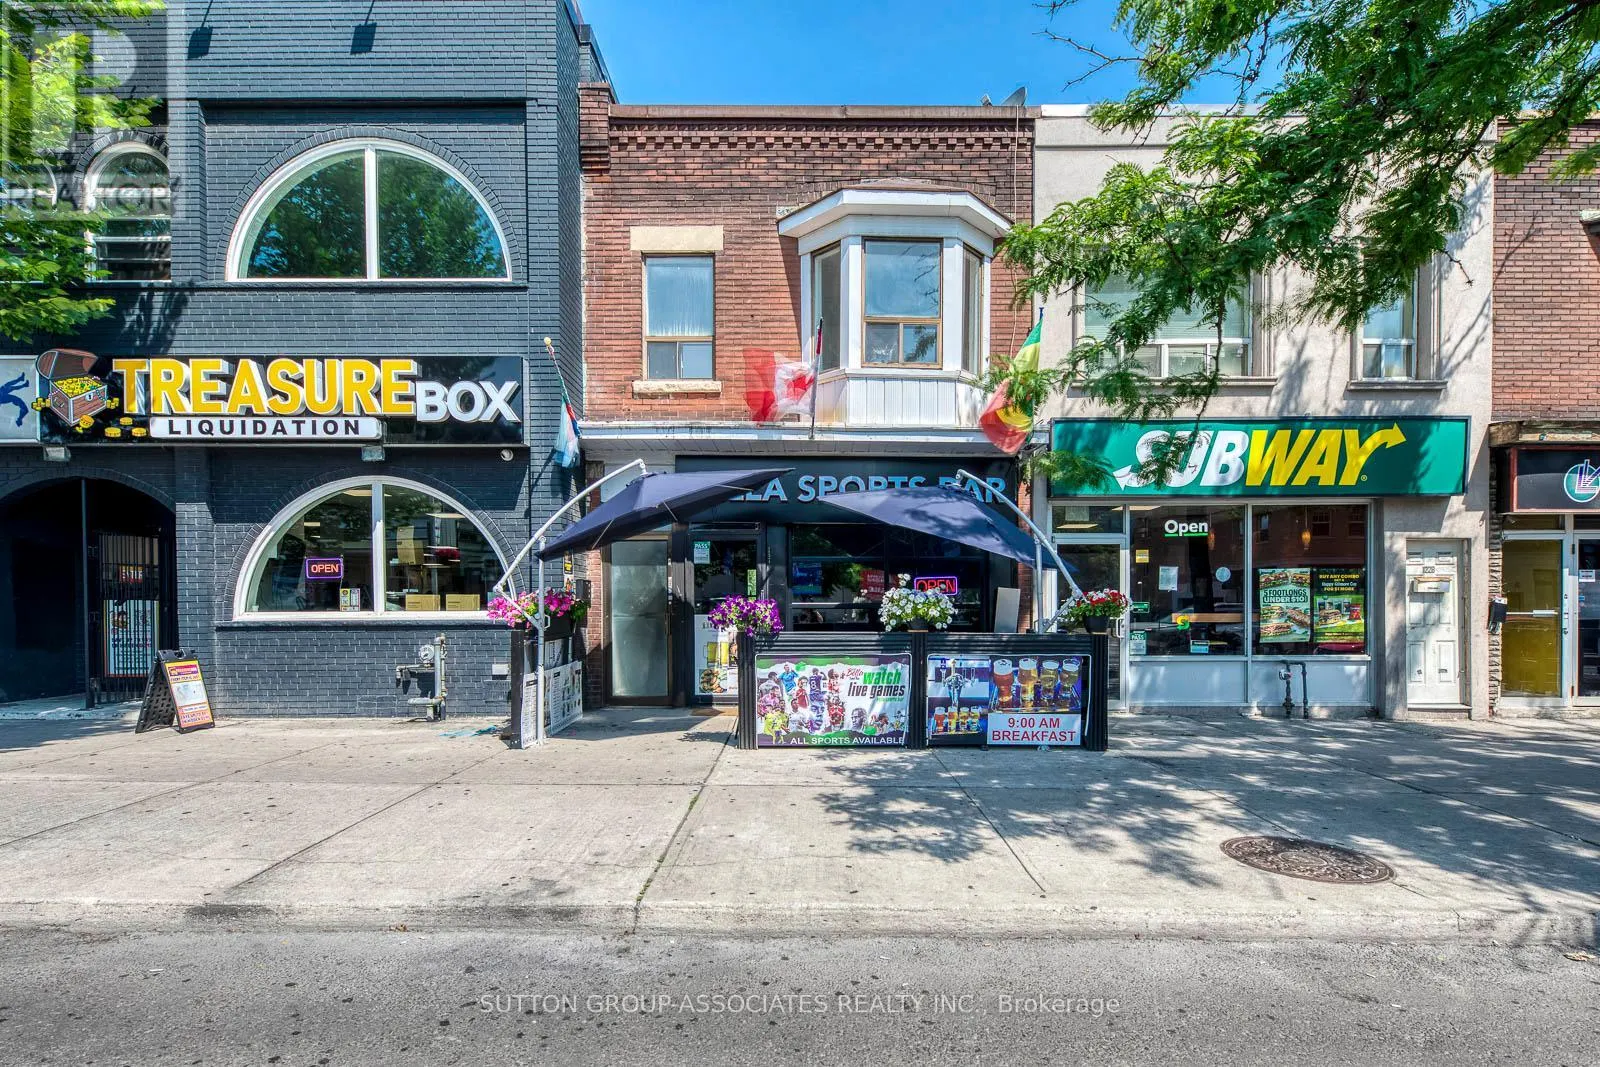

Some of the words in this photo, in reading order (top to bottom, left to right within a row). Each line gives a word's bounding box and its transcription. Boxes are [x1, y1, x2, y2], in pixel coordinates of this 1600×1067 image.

[112, 358, 420, 416] TREASURE
[415, 380, 521, 423] BOX
[168, 419, 360, 436] LIQUIDATION
[1113, 422, 1406, 491] SUBWAY
[1164, 519, 1208, 537] Open
[311, 564, 339, 573] OPEN
[916, 579, 955, 593] OPEN
[1268, 588, 1307, 596] FOOTLONGS
[863, 668, 902, 685] watch
[847, 682, 868, 697] live
[870, 685, 906, 699] games
[1008, 717, 1035, 729] 9:00
[1039, 717, 1060, 729] AM
[790, 737, 808, 745] ALL
[811, 737, 850, 745] SPORTS
[853, 737, 905, 745] AVAILABLE
[992, 730, 1076, 742] BREAKFAST
